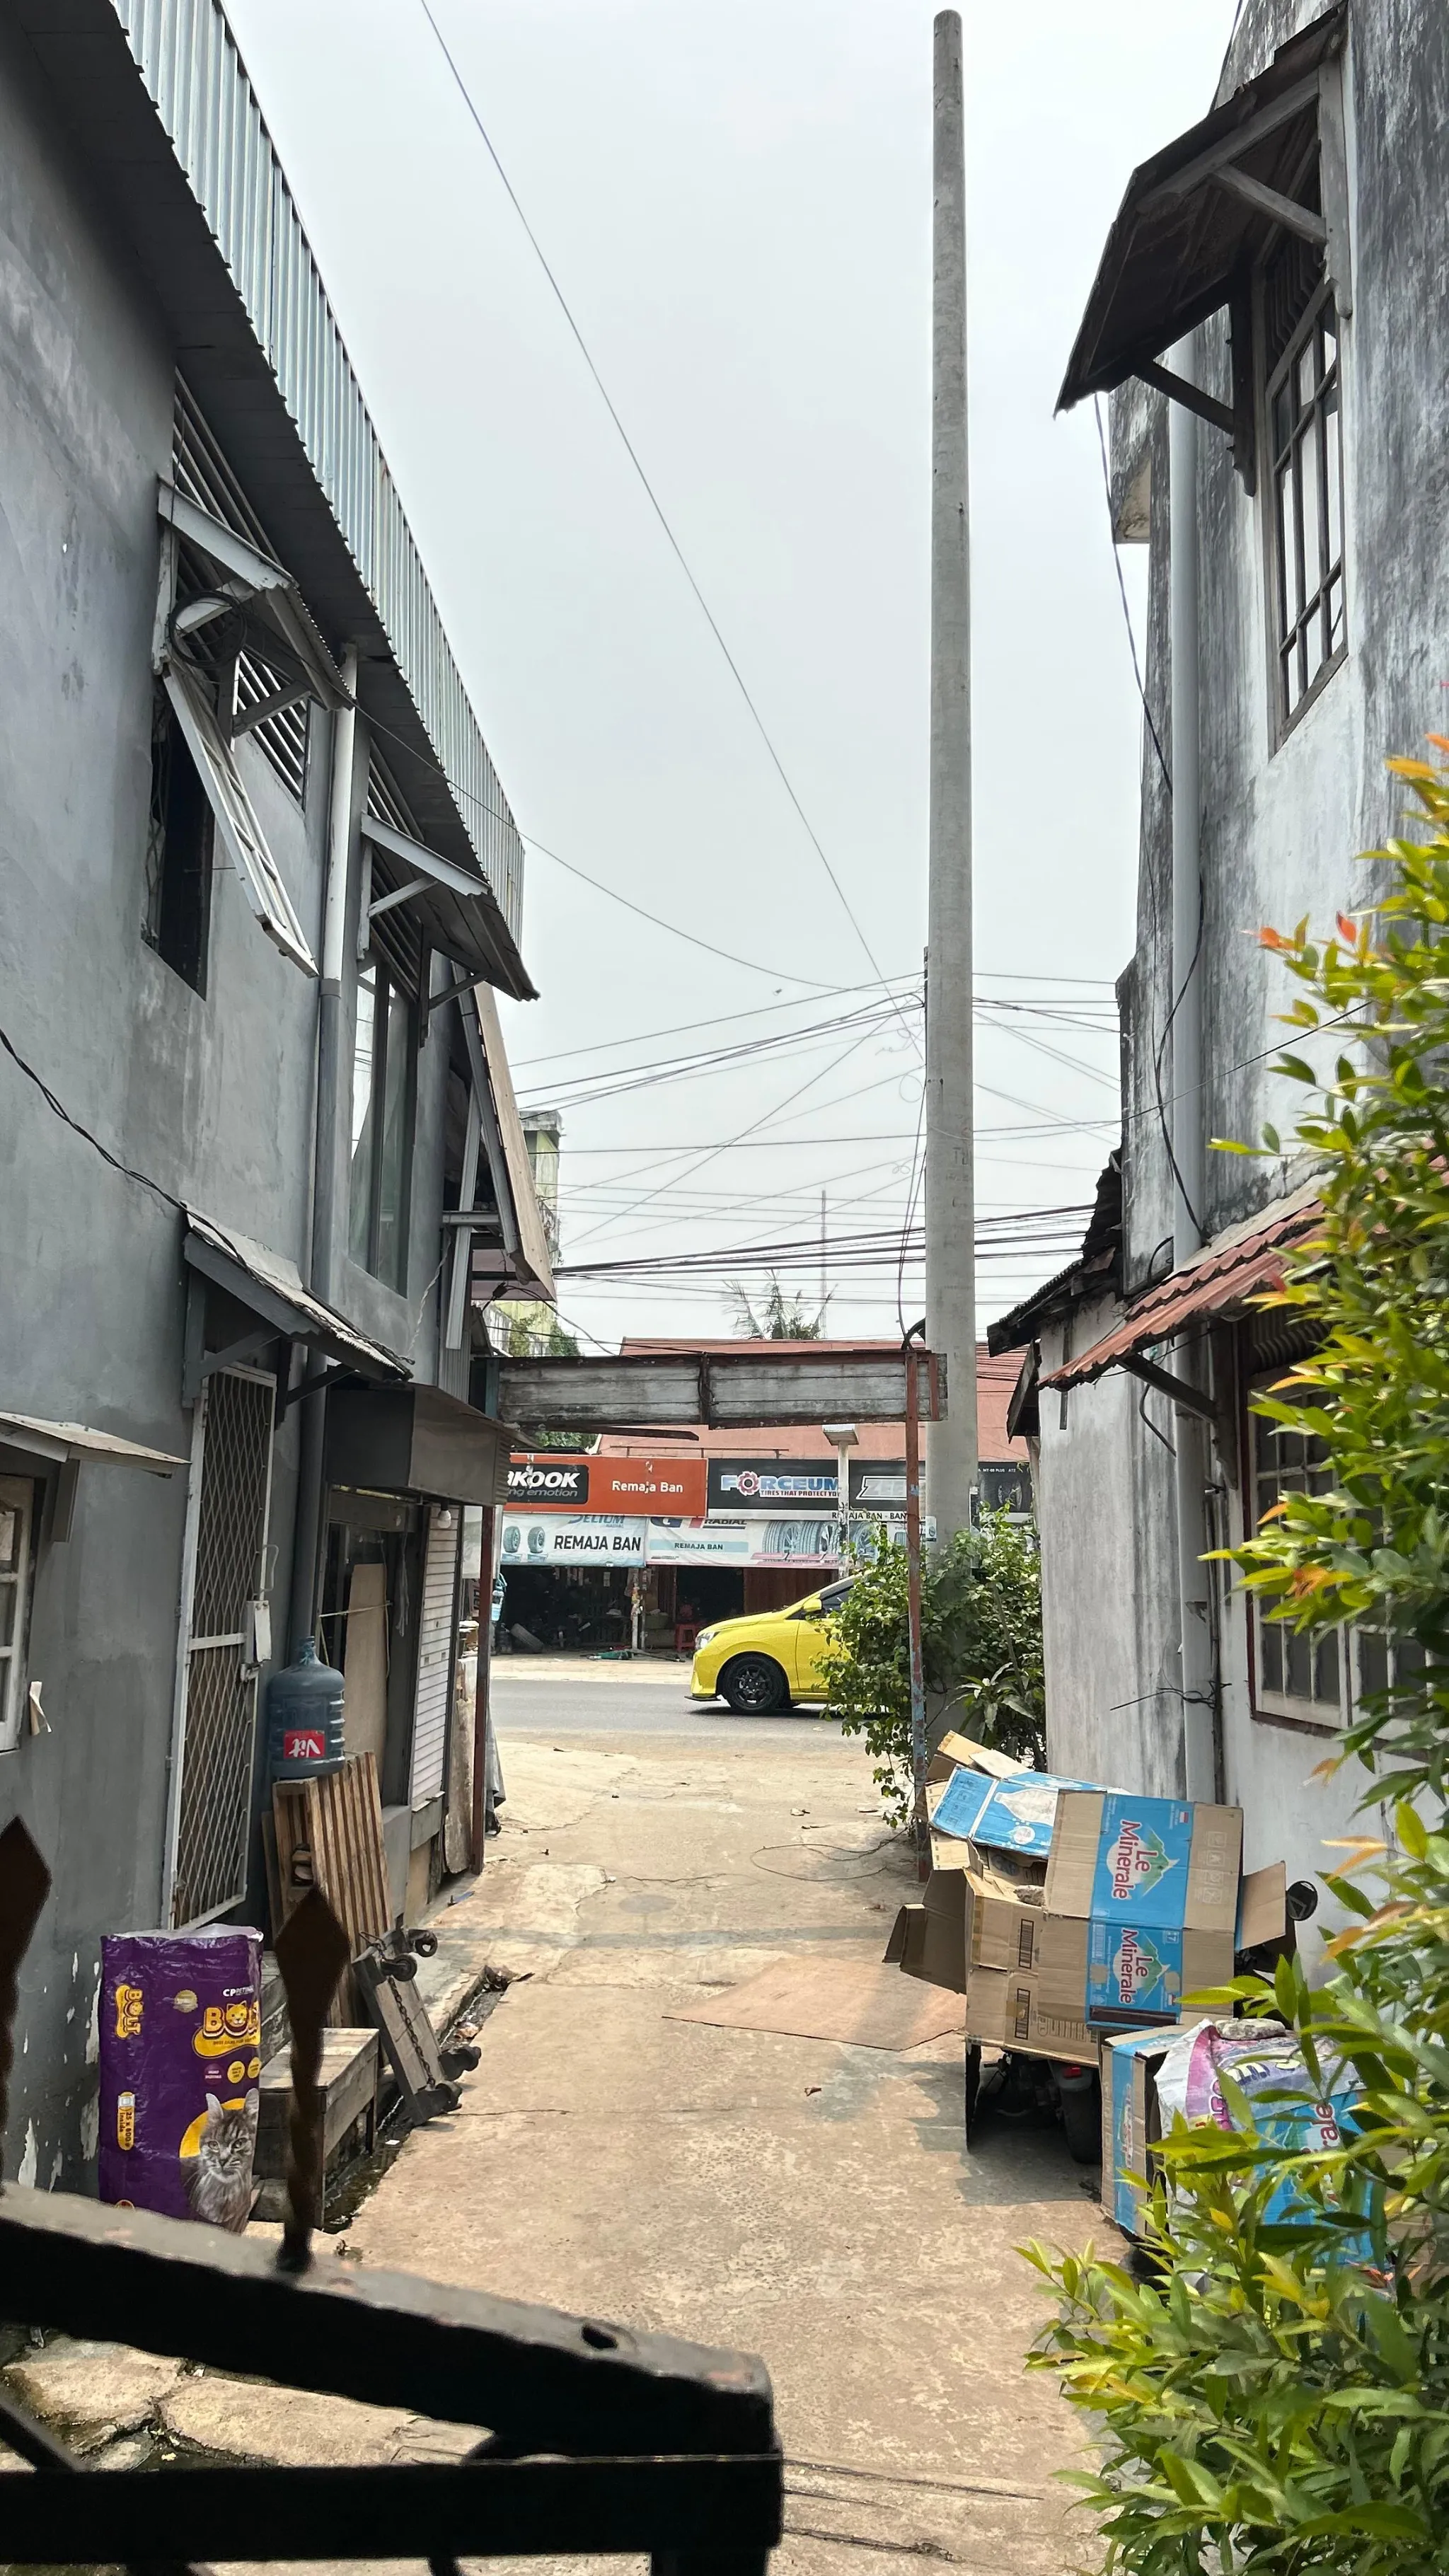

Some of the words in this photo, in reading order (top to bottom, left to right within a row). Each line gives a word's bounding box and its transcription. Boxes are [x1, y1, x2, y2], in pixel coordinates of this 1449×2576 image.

[527, 1488, 578, 1497] emotion
[612, 1481, 656, 1494] Remaja
[660, 1482, 683, 1493] Ban
[721, 1471, 838, 1496] FORCEUM
[554, 1535, 608, 1550] REMAJA
[613, 1536, 641, 1552] BAN
[1112, 1820, 1142, 1900] Minerale
[1134, 1849, 1158, 1873] Le
[1120, 1928, 1138, 2005] Minerale
[1135, 1956, 1153, 1978] Le
